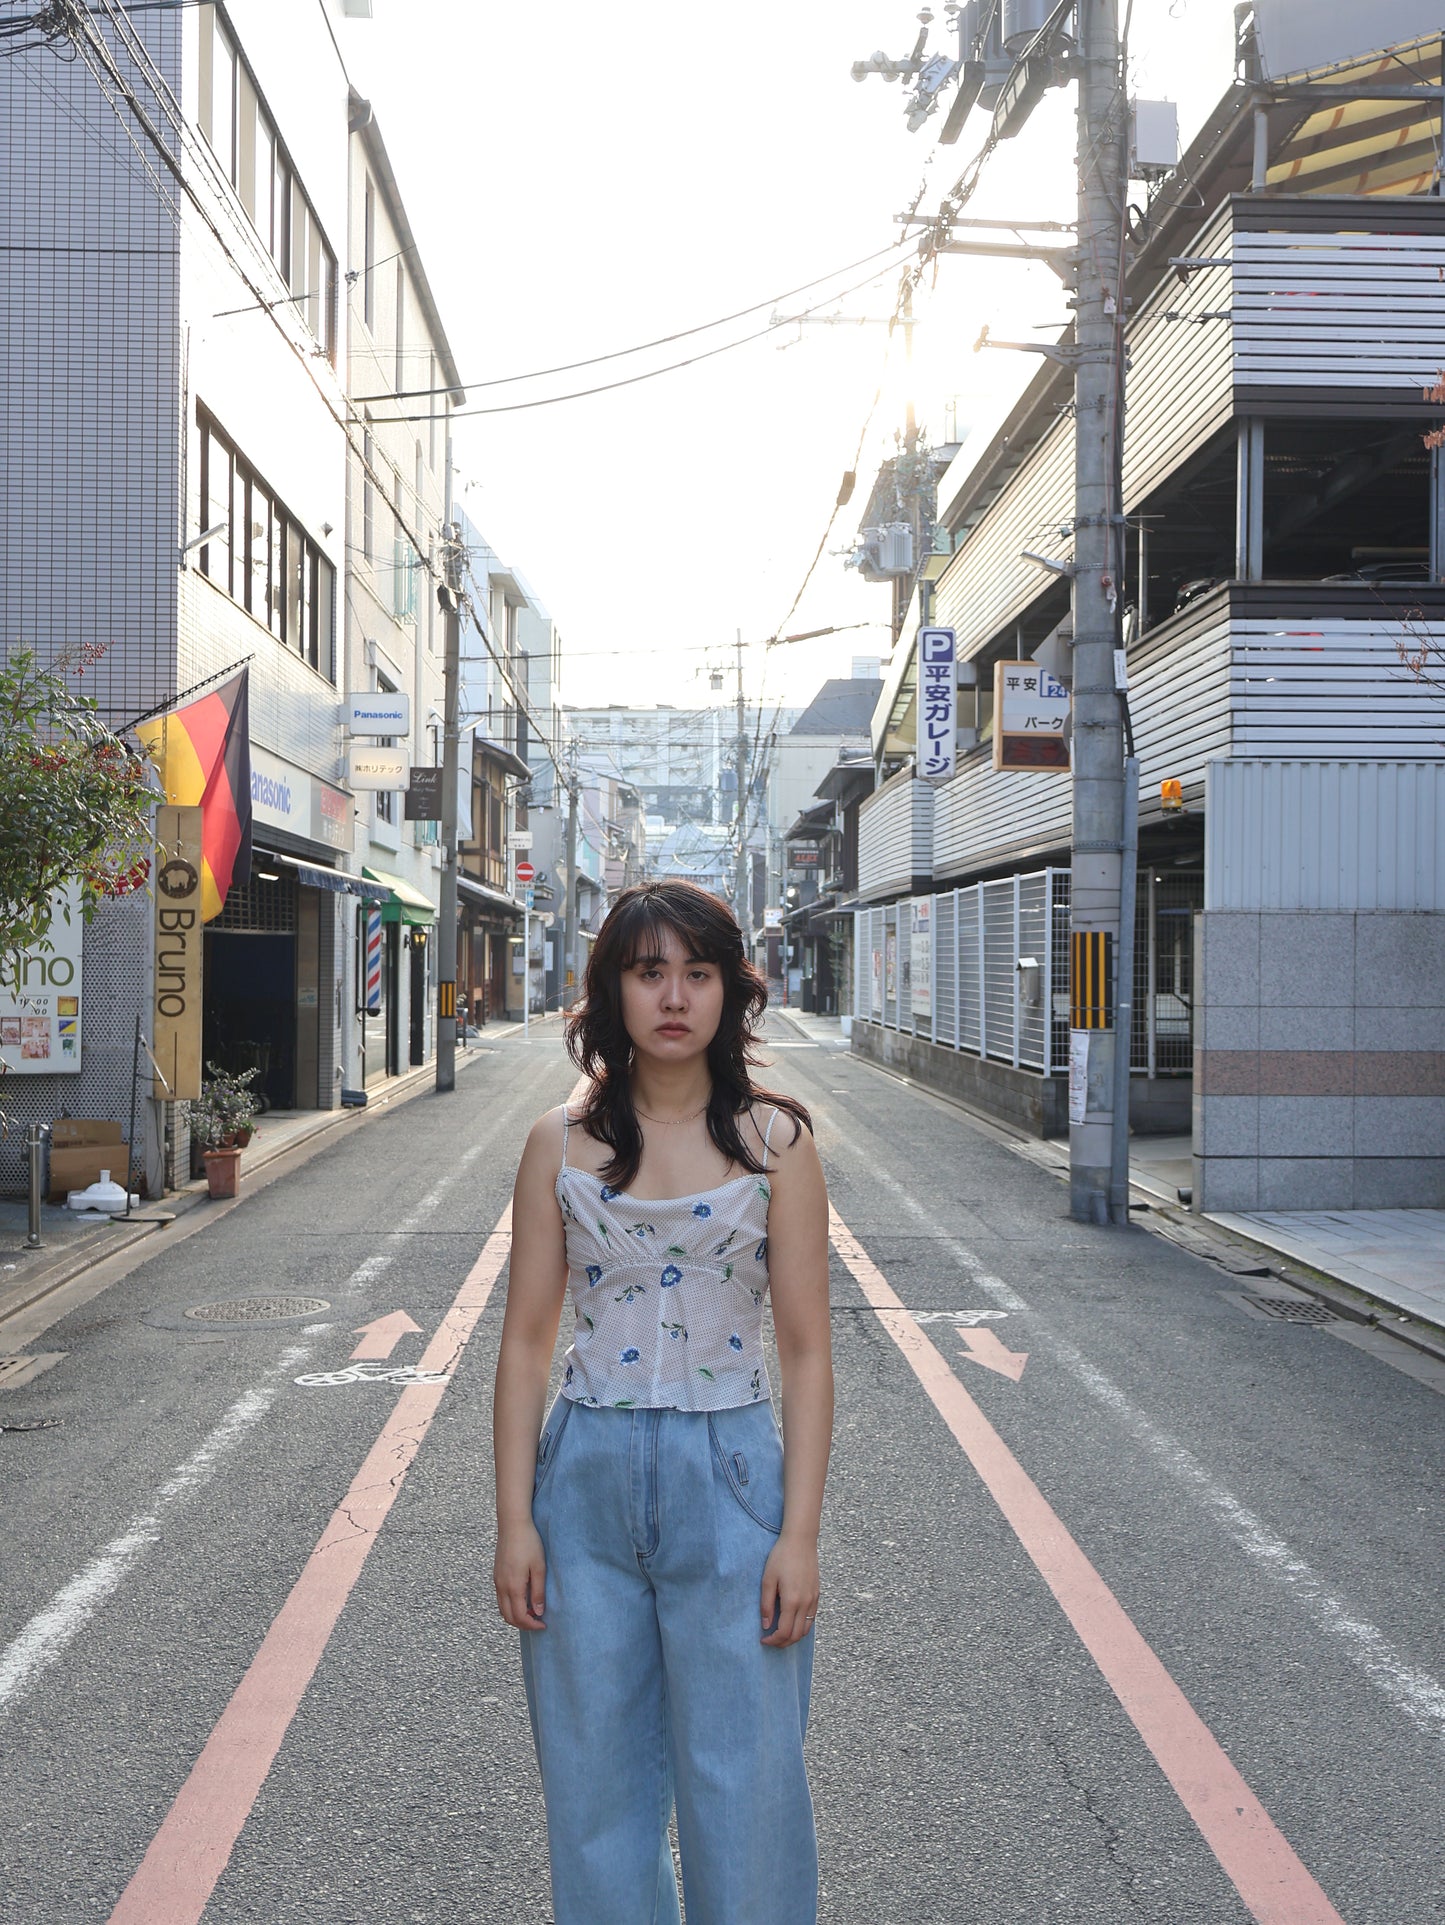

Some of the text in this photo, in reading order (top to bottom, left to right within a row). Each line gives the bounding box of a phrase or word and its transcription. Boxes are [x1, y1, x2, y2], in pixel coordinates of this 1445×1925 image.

[1006, 677, 1037, 691] 平安
[354, 710, 403, 719] Panasonic
[925, 665, 952, 775] 平安ガレージ
[251, 771, 291, 815] anasonic
[158, 909, 195, 1017] Bruno
